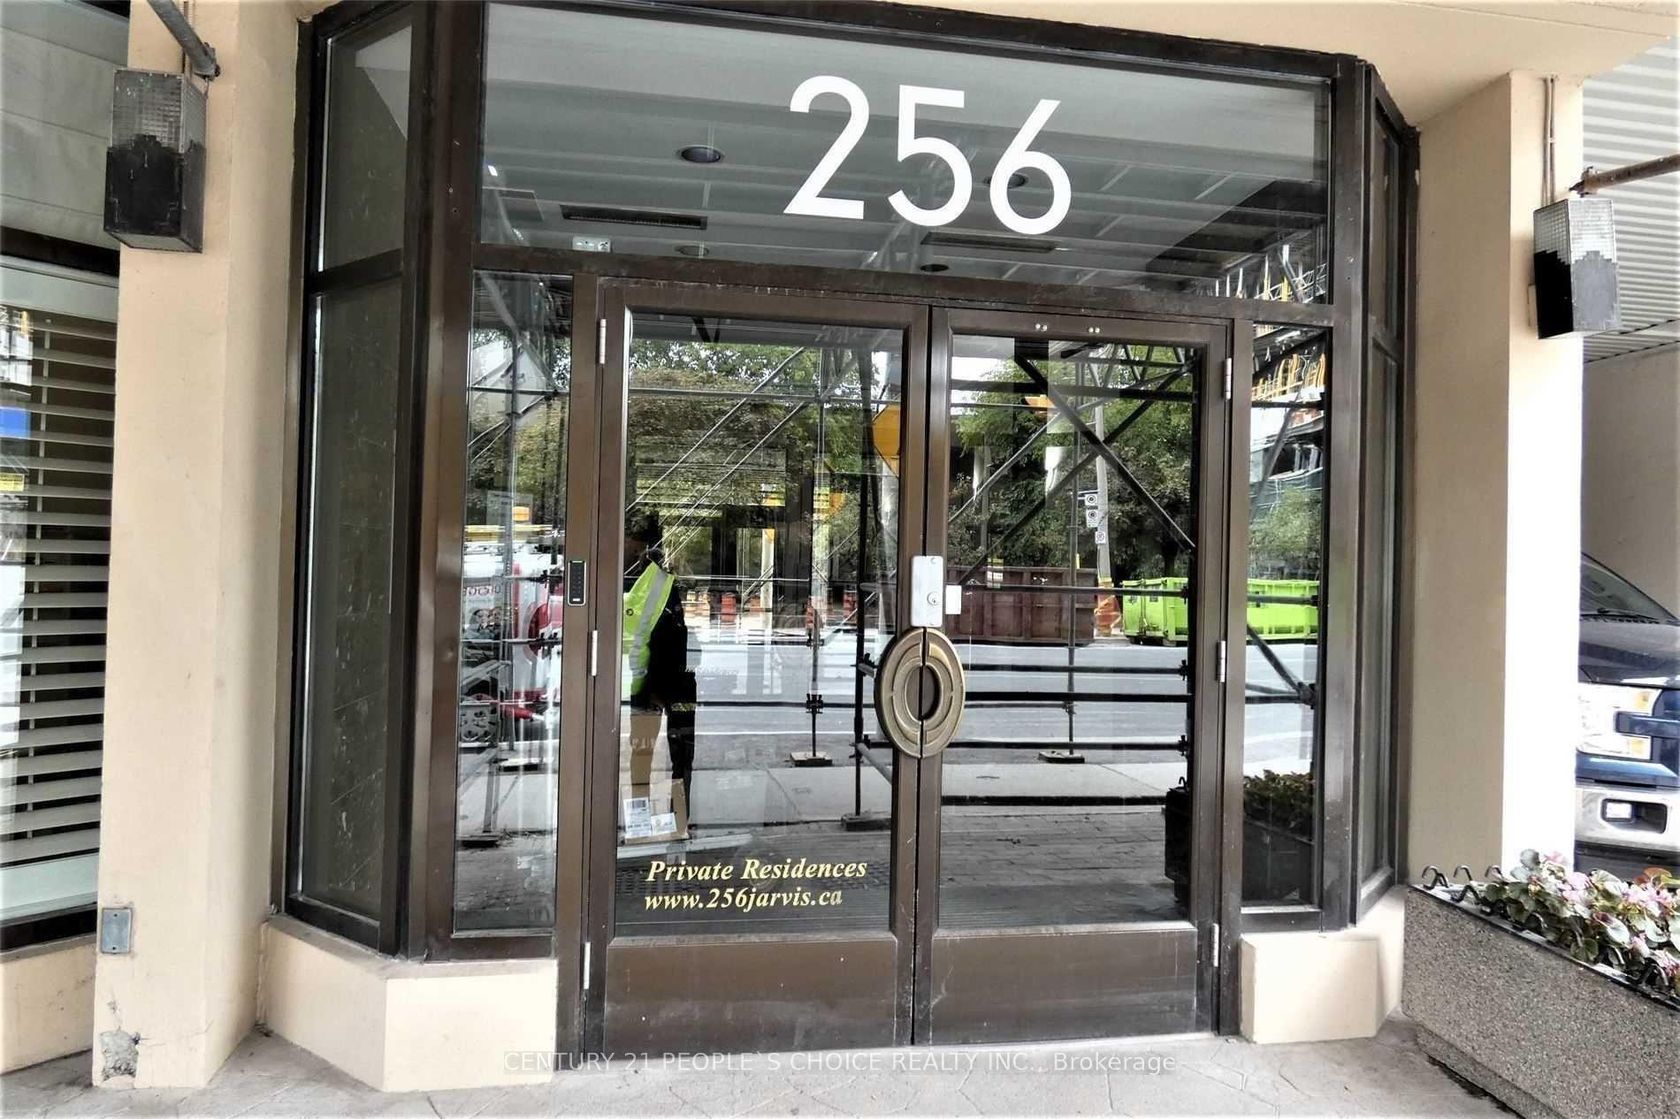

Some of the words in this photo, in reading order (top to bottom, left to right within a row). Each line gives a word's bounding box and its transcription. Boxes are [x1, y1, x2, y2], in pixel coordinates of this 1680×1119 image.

[783, 75, 1072, 235] 256
[646, 859, 734, 883] Private
[741, 858, 867, 880] Residences
[644, 887, 843, 912] www.256jarvis.ca
